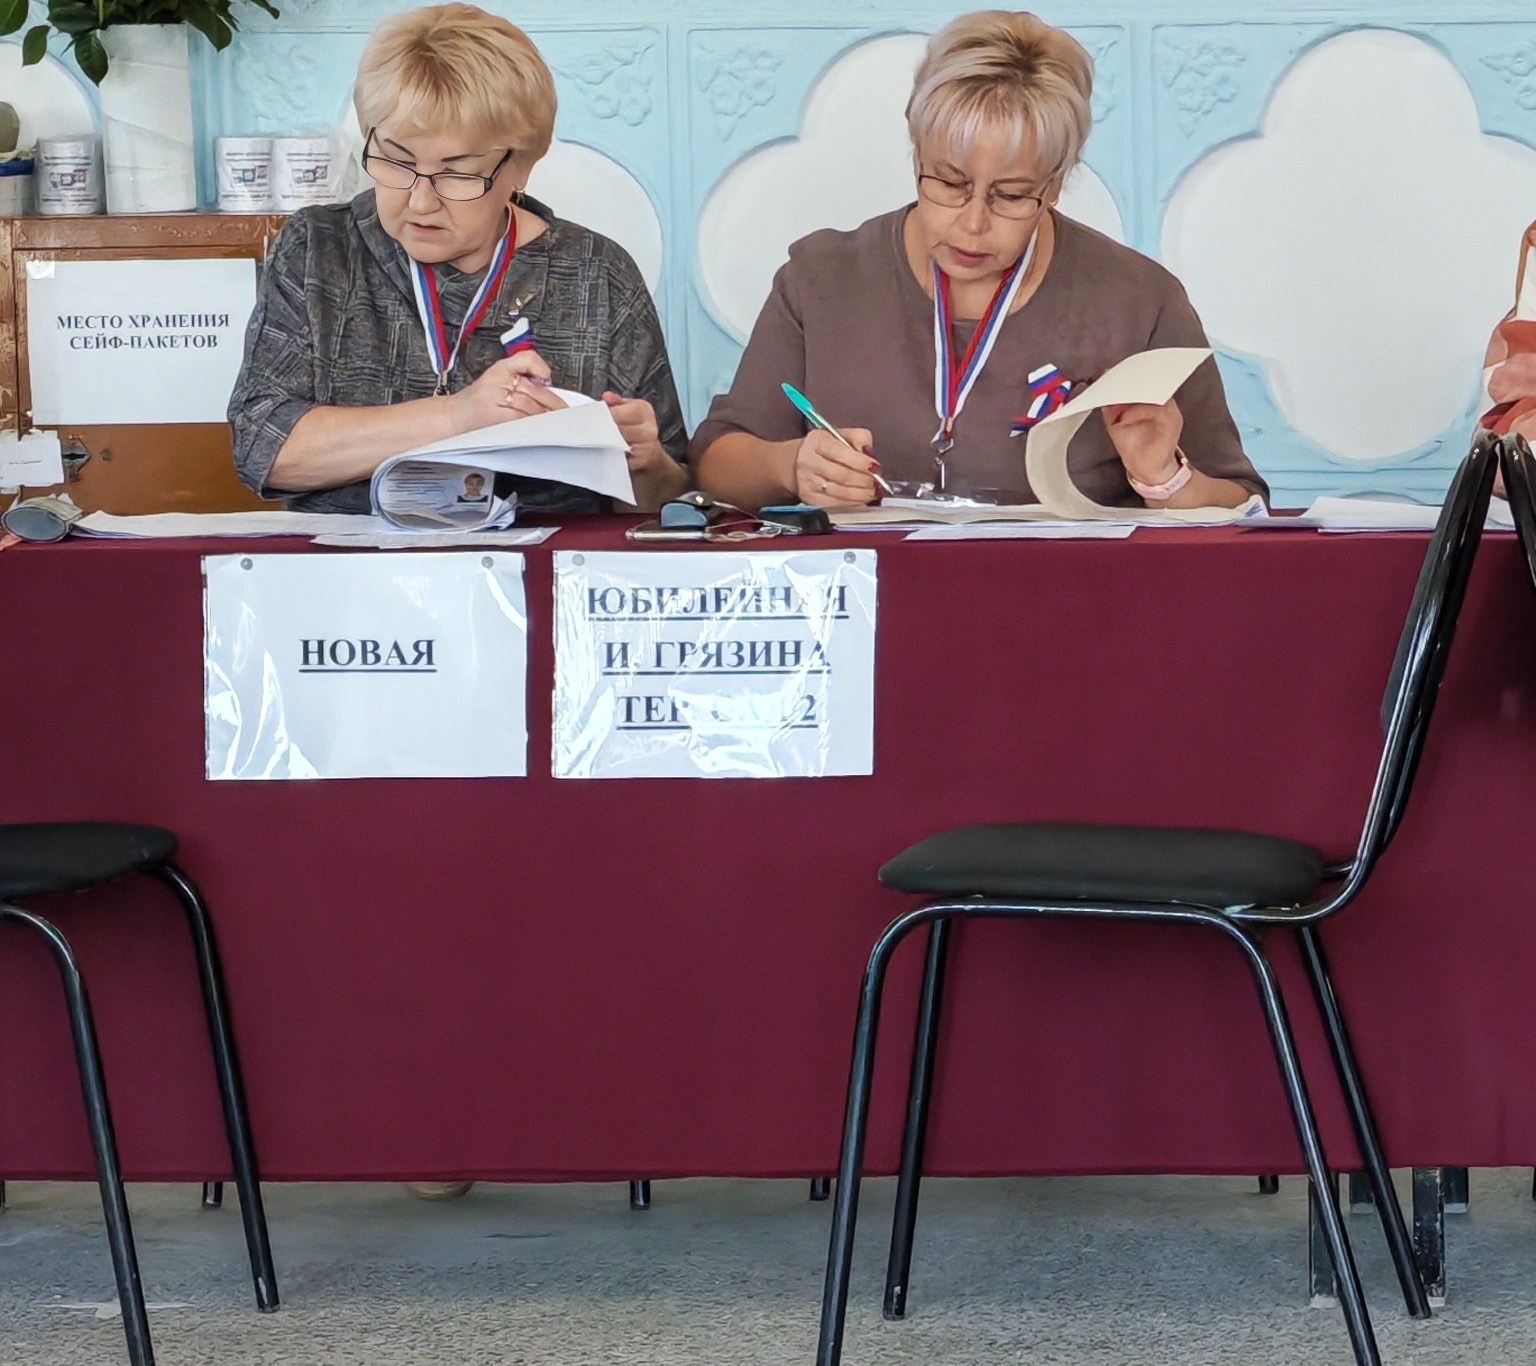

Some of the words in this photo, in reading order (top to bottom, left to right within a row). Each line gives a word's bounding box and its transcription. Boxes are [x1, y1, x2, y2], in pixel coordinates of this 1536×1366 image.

[56, 314, 124, 330] МЕСТО
[127, 313, 230, 330] ХРАНЕНИЯ
[69, 333, 219, 350] СЕЙФ-ПАКЕТОВ
[299, 638, 436, 666] НОВАЯ
[654, 639, 832, 669] ГРЯЗИНА
